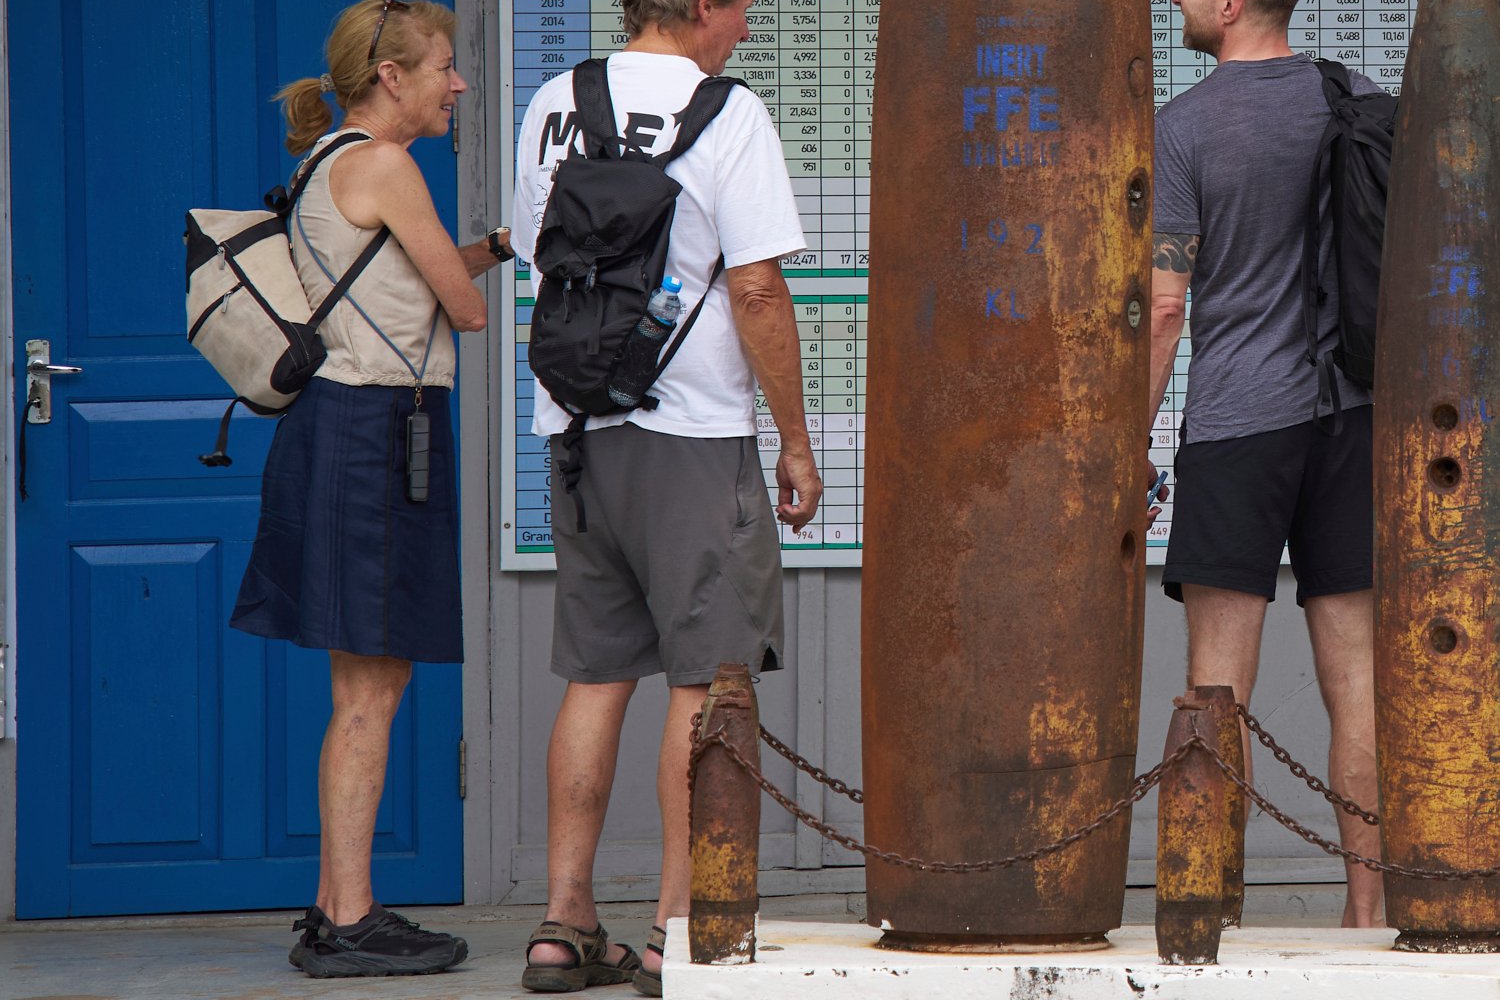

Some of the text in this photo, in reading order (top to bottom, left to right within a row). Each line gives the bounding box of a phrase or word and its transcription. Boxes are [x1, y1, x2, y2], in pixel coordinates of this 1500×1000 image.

[541, 52, 565, 63] 2016
[976, 44, 1049, 78] INERT
[962, 86, 1060, 132] FFE
[985, 287, 1026, 319] KL
